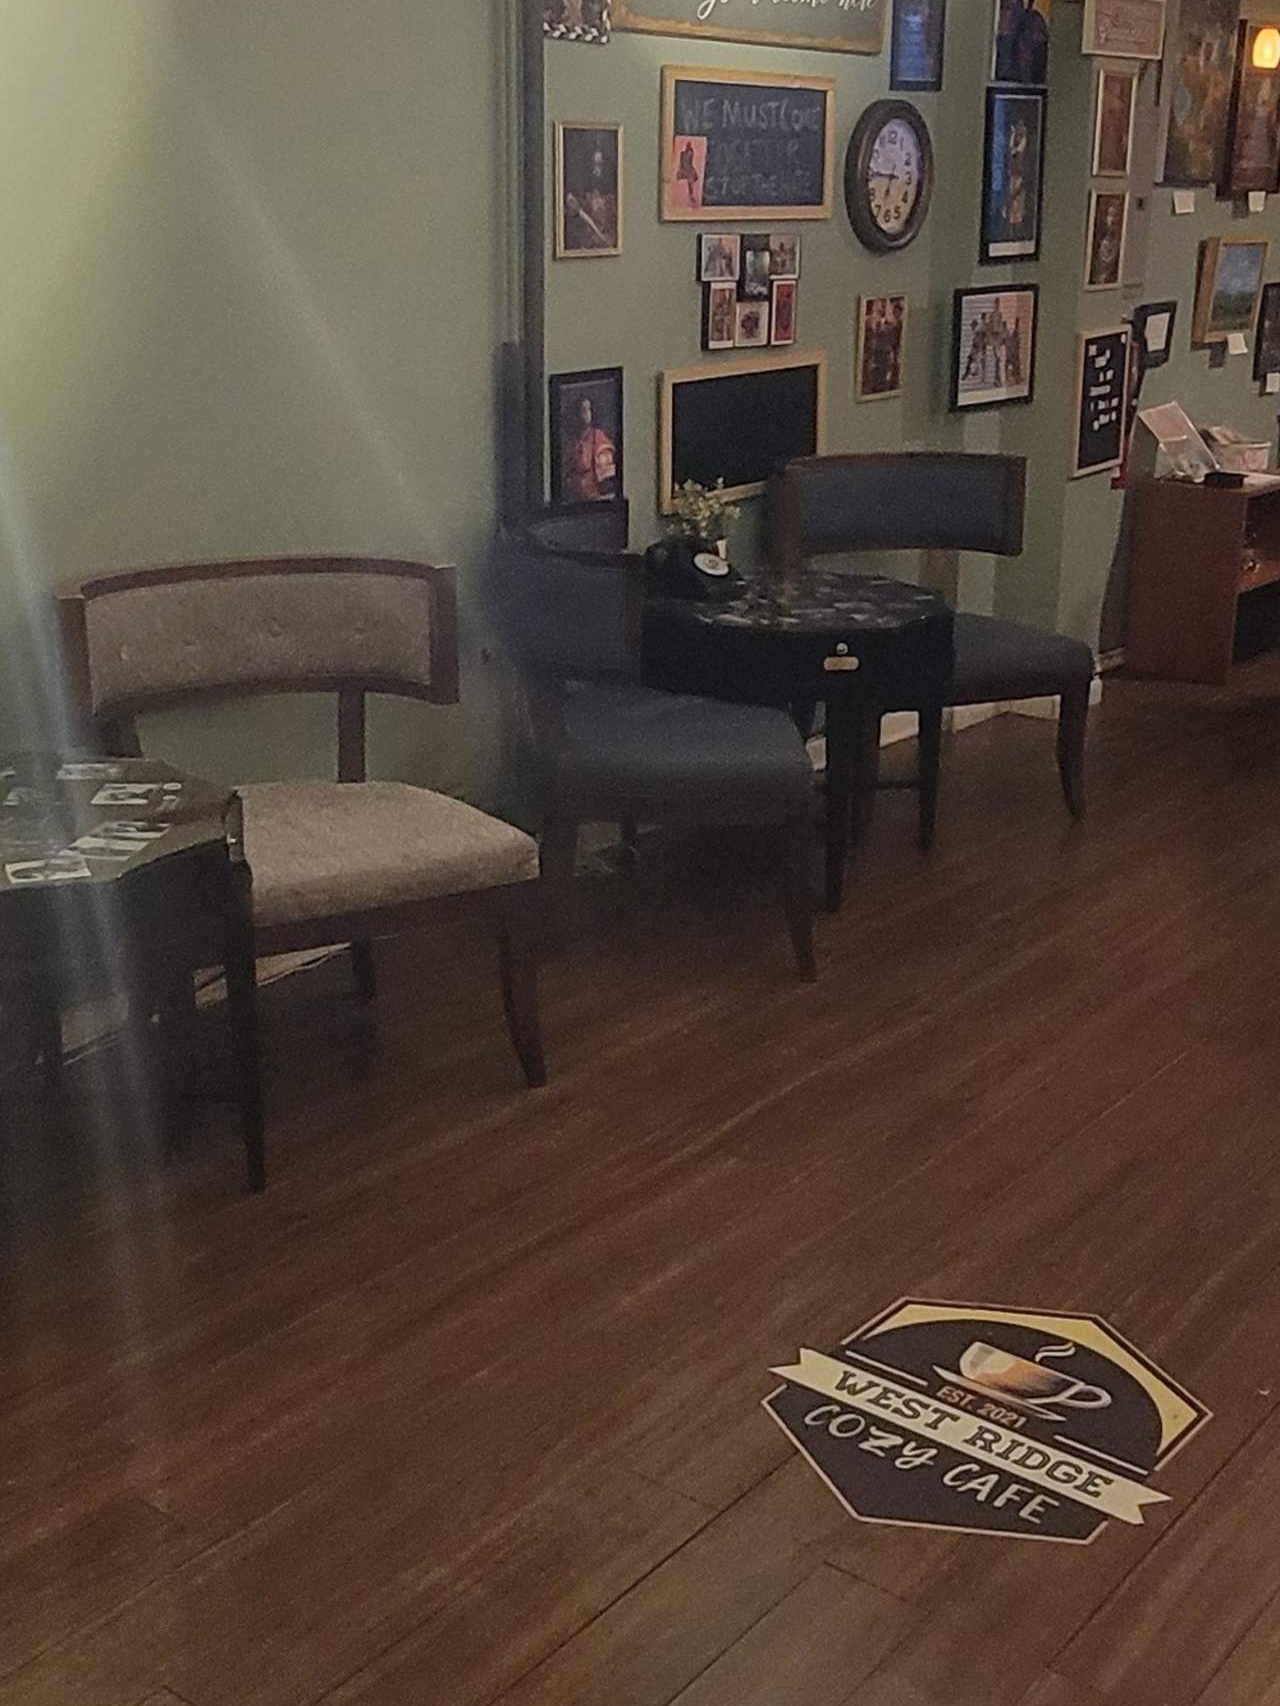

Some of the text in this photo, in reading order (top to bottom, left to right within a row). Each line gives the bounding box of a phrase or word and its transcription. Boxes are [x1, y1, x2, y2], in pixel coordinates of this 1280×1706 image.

[804, 1403, 1061, 1525] COZY CAFE
[834, 1369, 1115, 1499] WEST RIDGE
[935, 1384, 1028, 1430] EST. 2021
